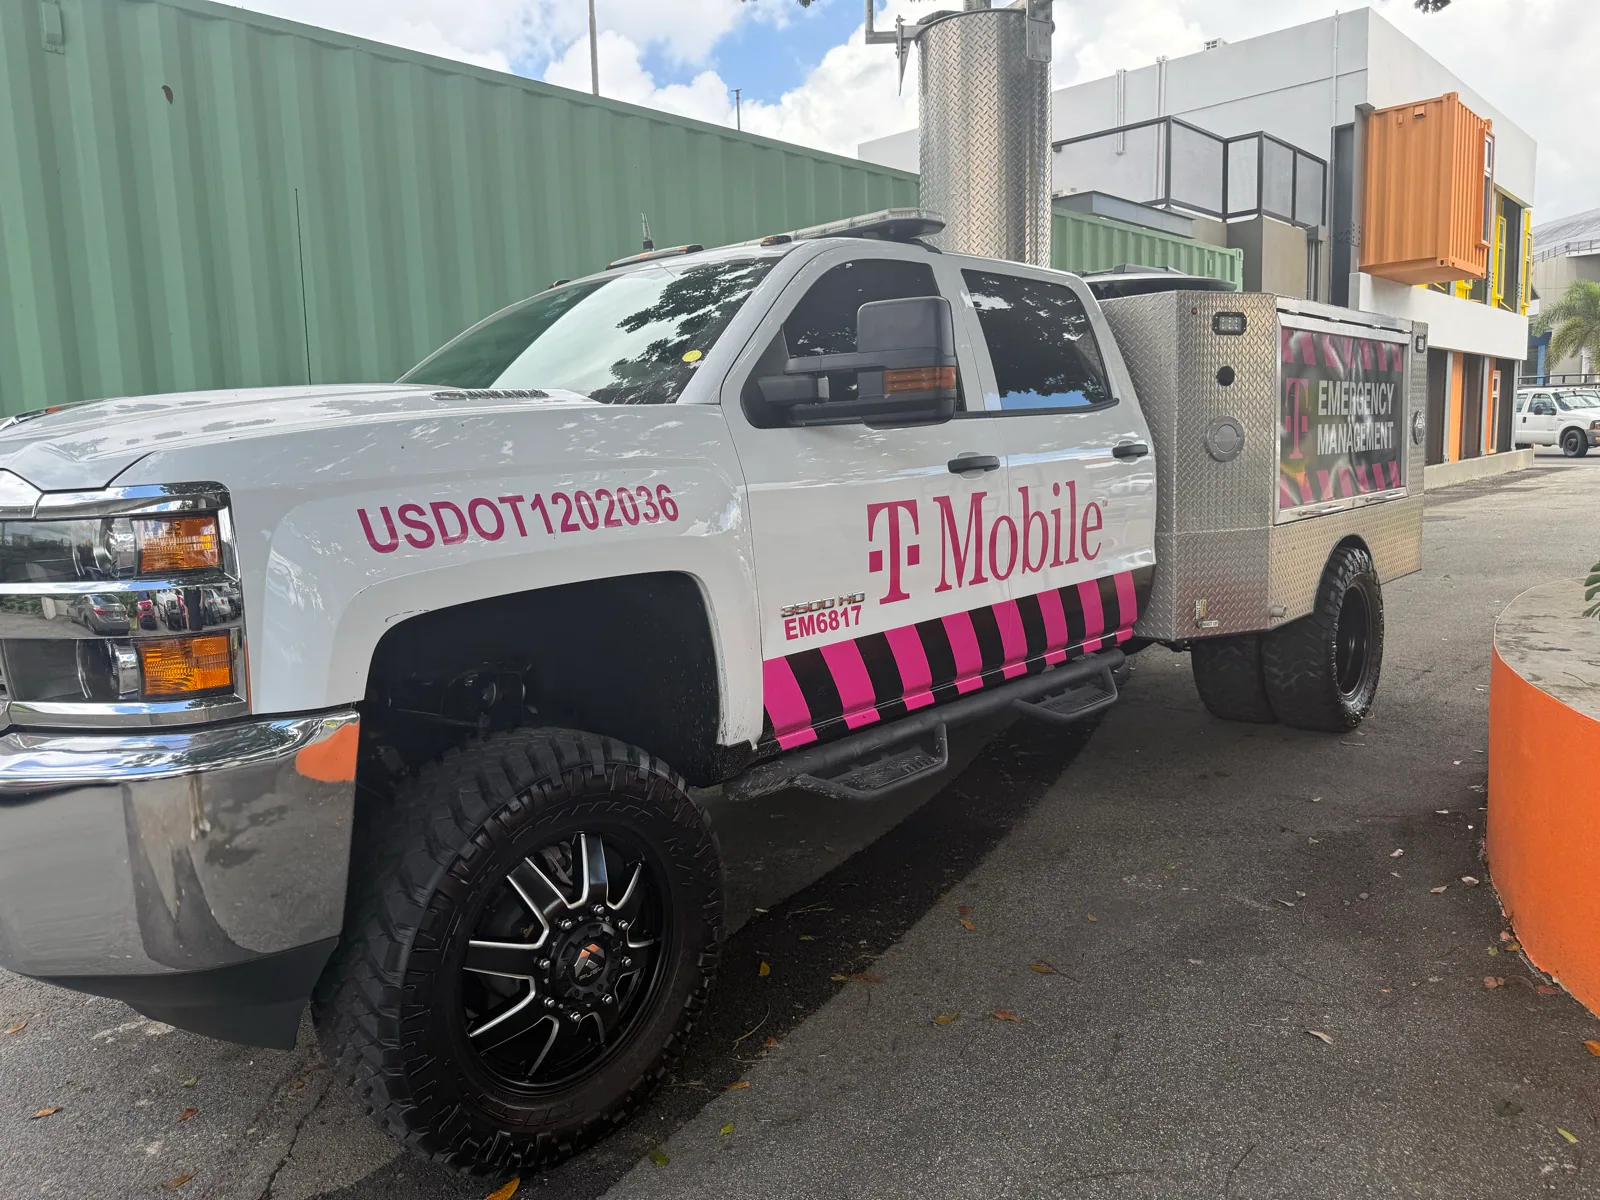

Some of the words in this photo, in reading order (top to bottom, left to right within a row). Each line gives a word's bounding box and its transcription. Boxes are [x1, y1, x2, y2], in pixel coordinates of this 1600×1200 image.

[1317, 379, 1395, 416] EMERGENCY
[1317, 421, 1394, 456] MANAGEMENT
[357, 484, 679, 554] USDOT1202036
[933, 480, 1103, 593] Mobile
[839, 590, 865, 606] HD
[784, 605, 862, 641] EM6817
